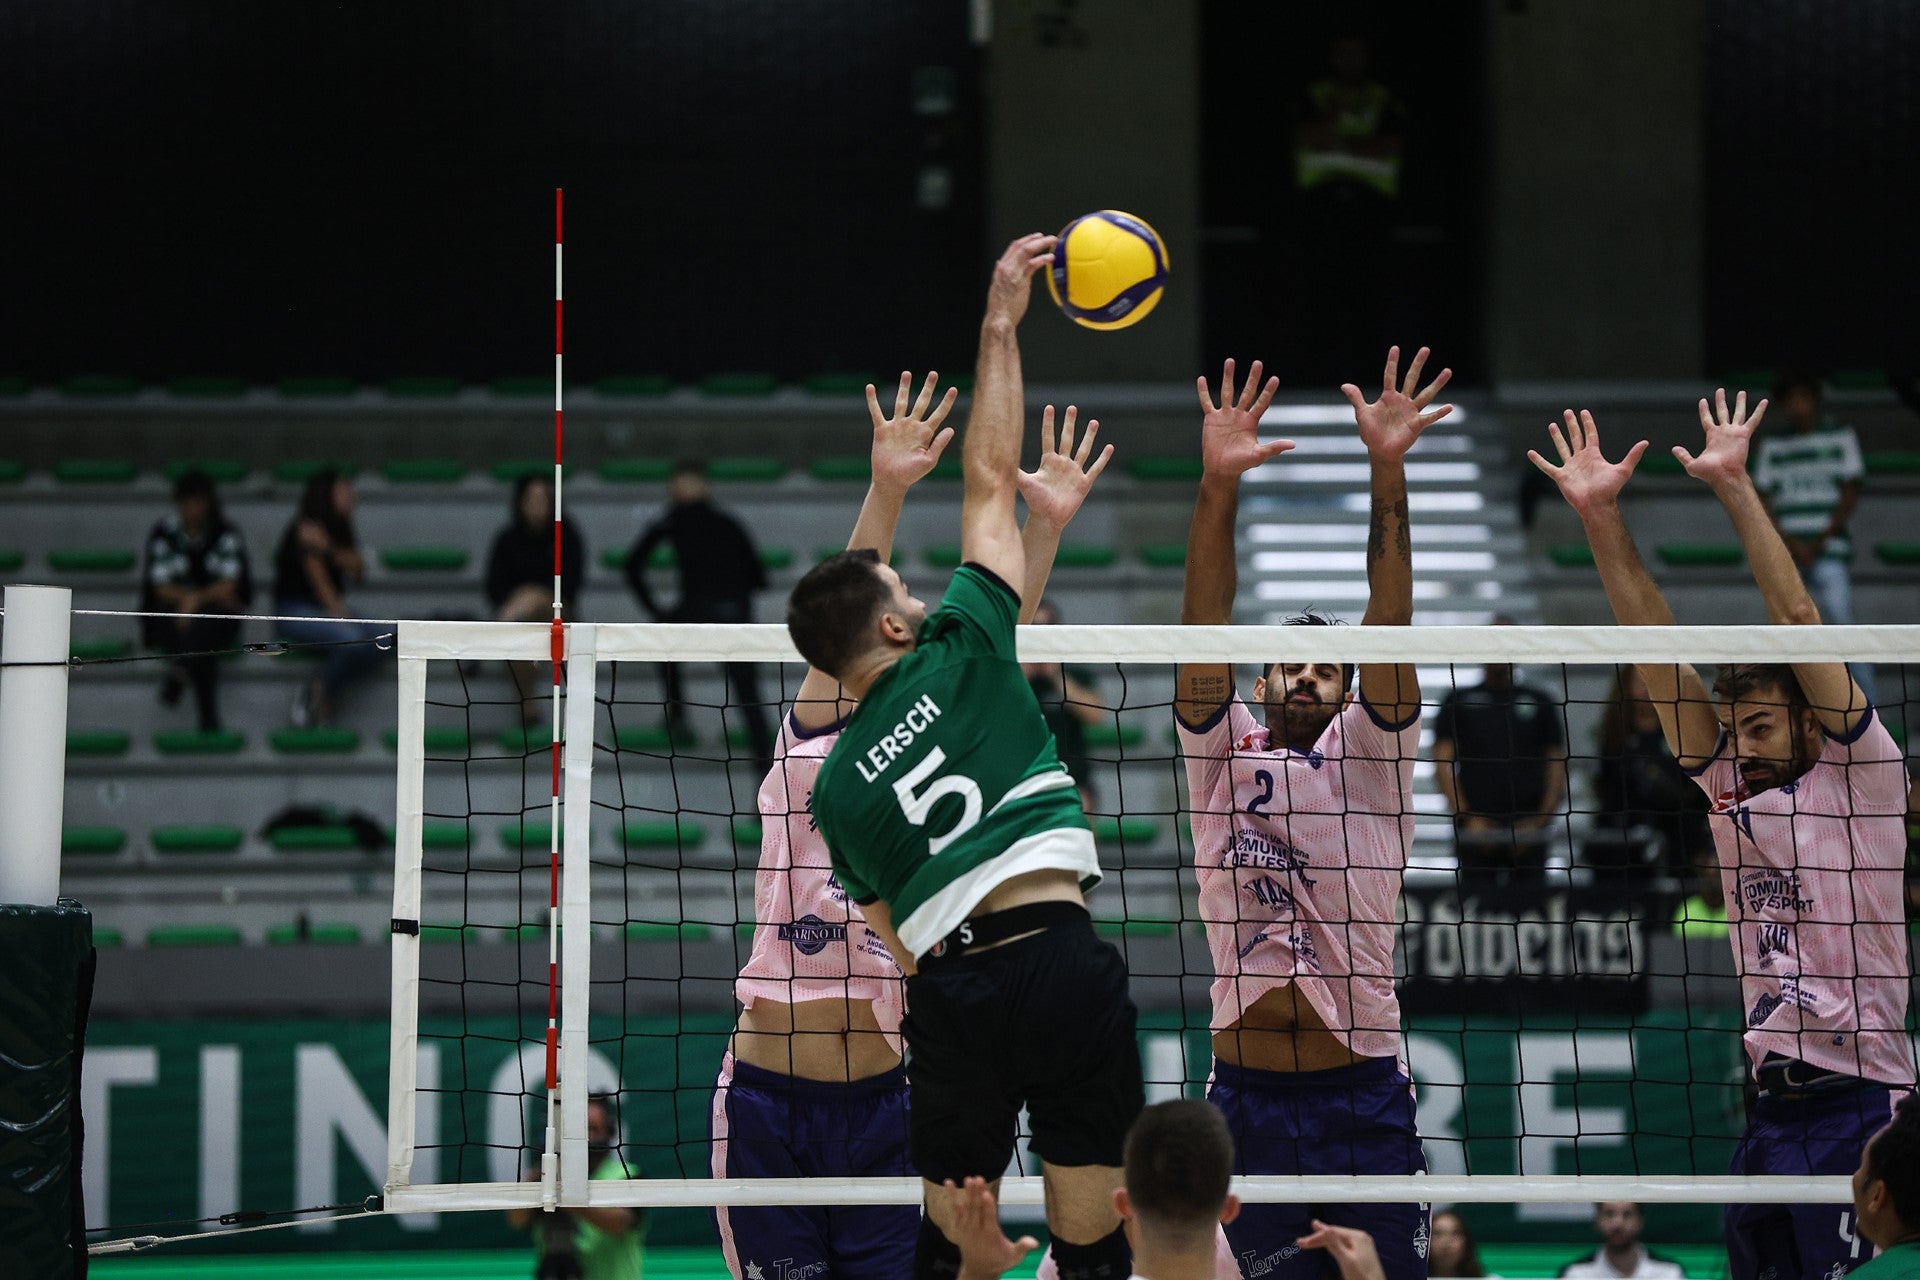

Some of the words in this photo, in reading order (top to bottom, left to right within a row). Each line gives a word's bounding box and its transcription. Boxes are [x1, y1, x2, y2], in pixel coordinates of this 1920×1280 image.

[854, 693, 942, 783] LERSCH
[891, 745, 984, 856] 5
[1247, 769, 1274, 820] 2
[781, 926, 829, 941] MARINO
[1241, 1242, 1302, 1275] Torres
